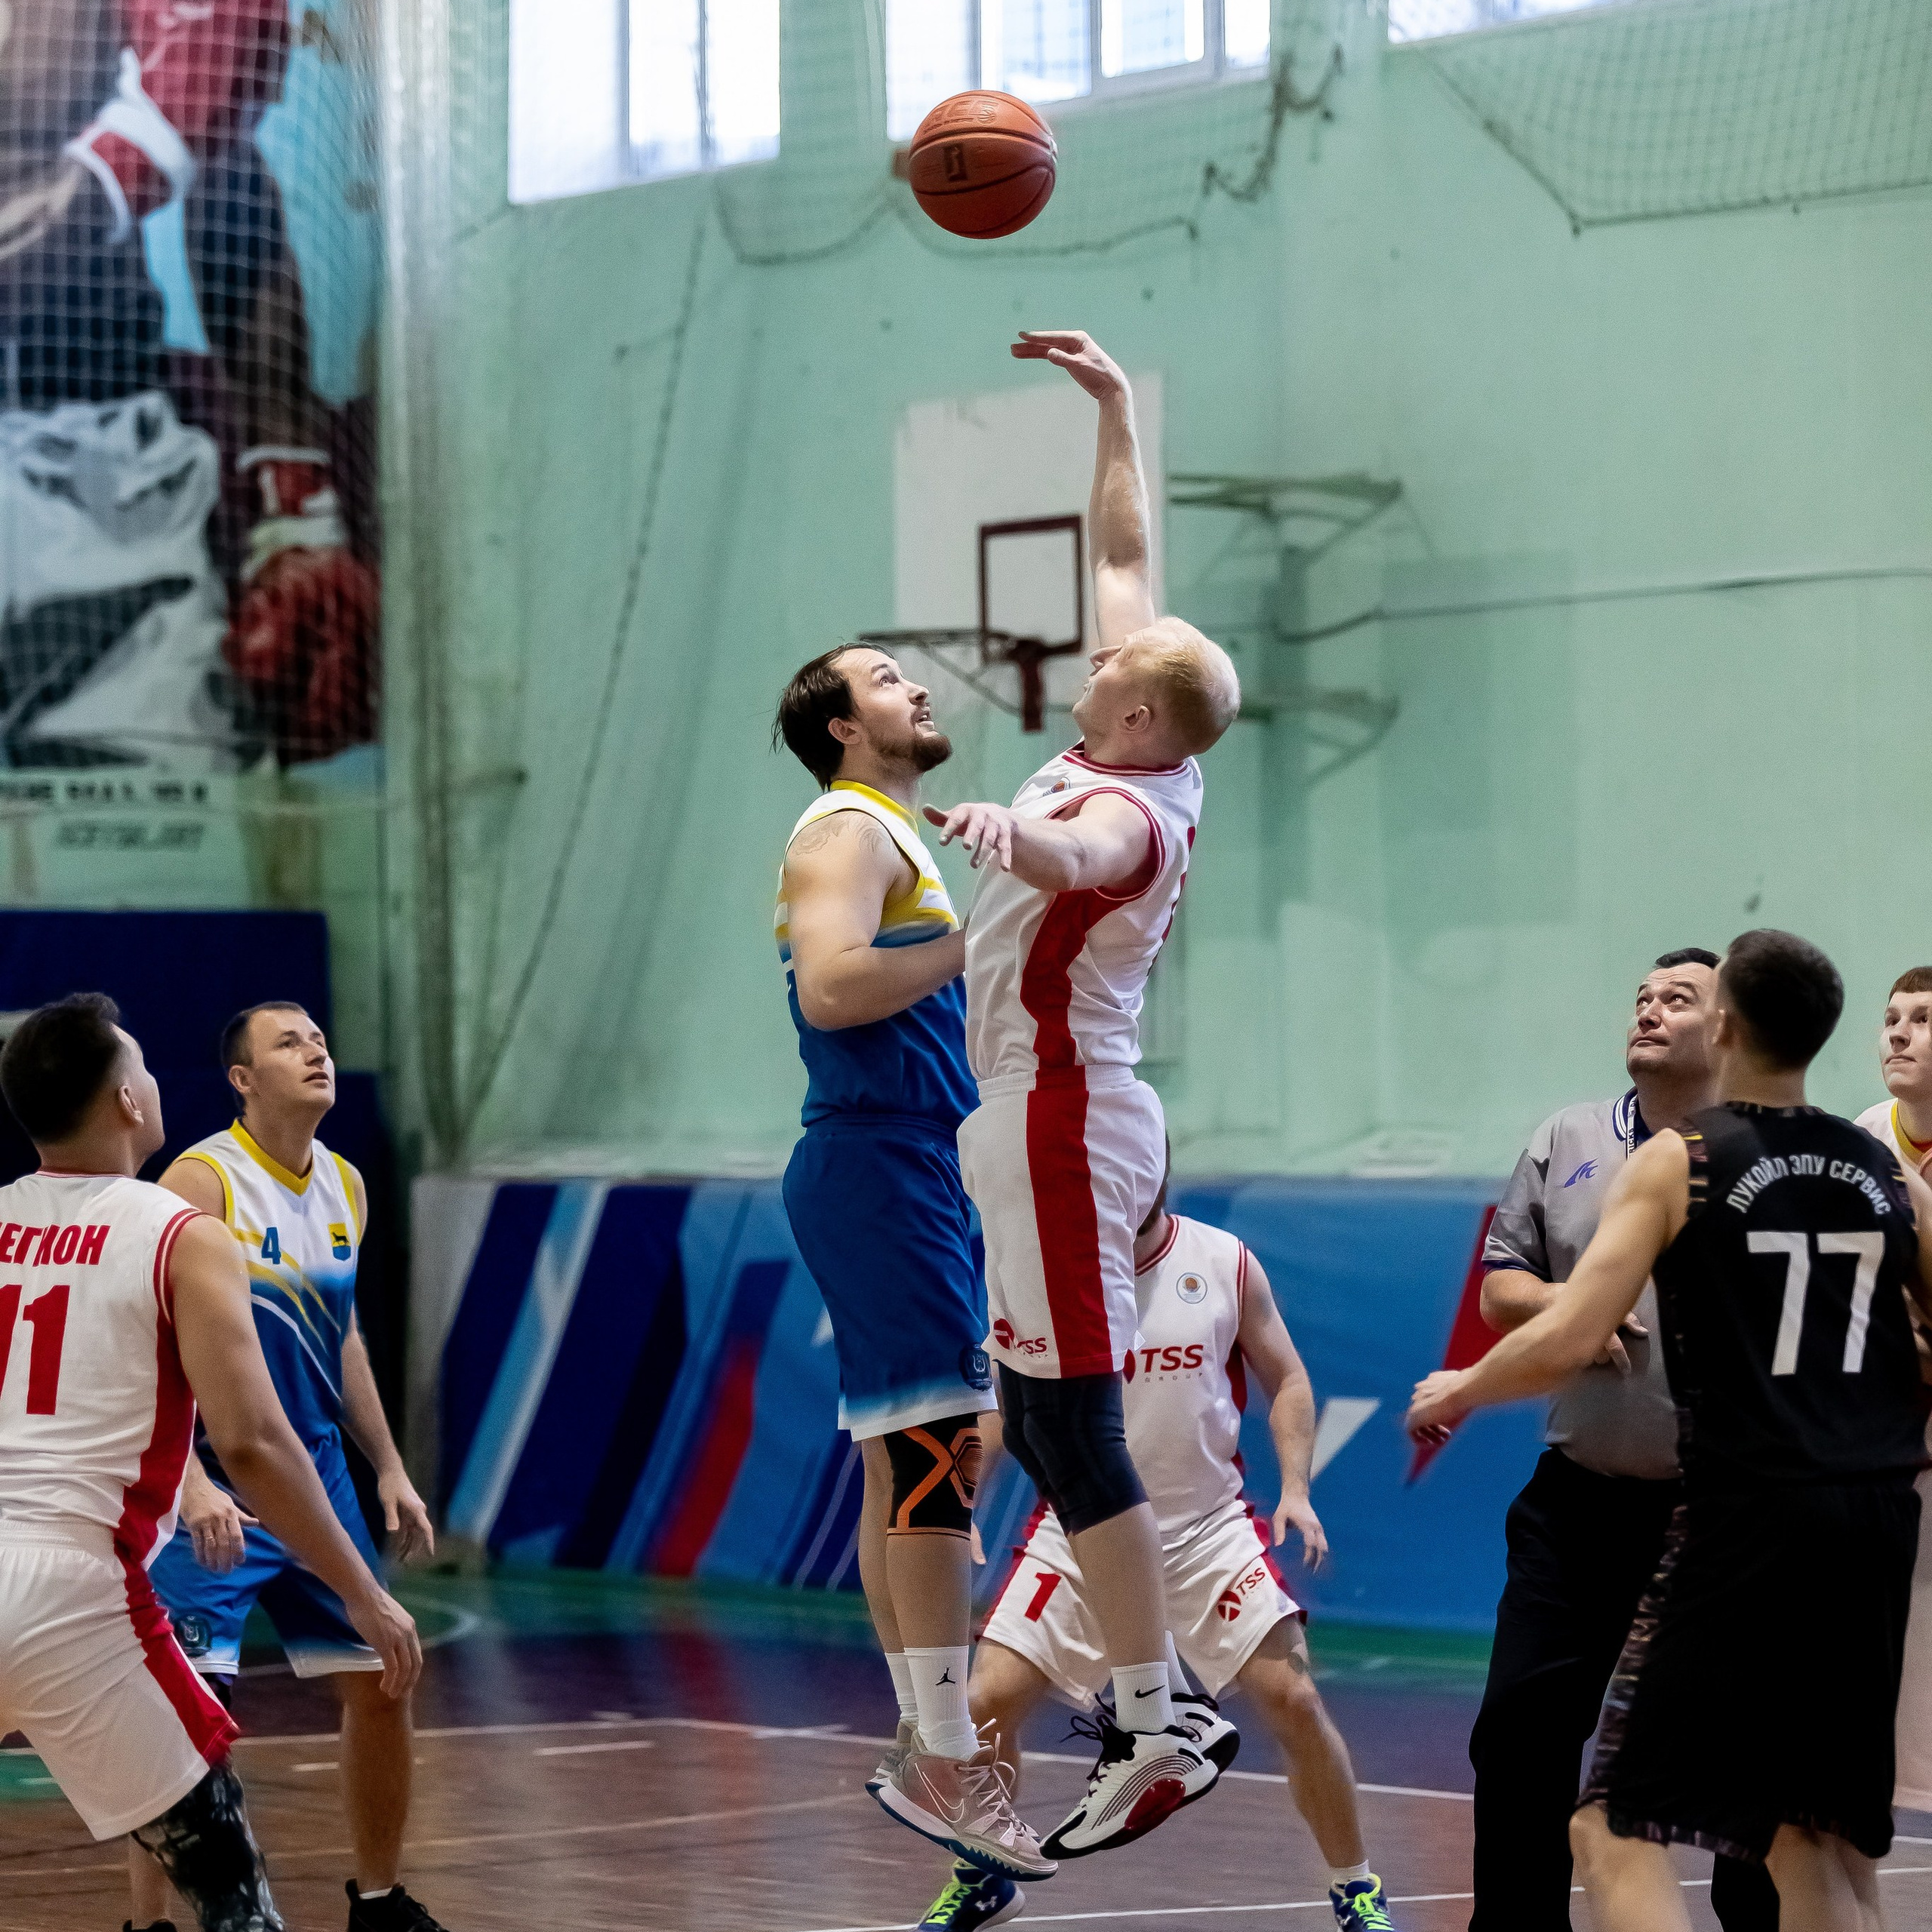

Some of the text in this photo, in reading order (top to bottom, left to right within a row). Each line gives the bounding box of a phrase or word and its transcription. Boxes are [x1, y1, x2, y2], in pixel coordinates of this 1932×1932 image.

[1828, 1160, 1891, 1215] СЕРВИС
[0, 1221, 111, 1267] ЕГИОН
[261, 1226, 281, 1265] 4
[1746, 1230, 1885, 1377] 77
[1140, 1344, 1204, 1374] TSS
[1023, 1572, 1062, 1623] 1
[1235, 1567, 1266, 1595] TSS
